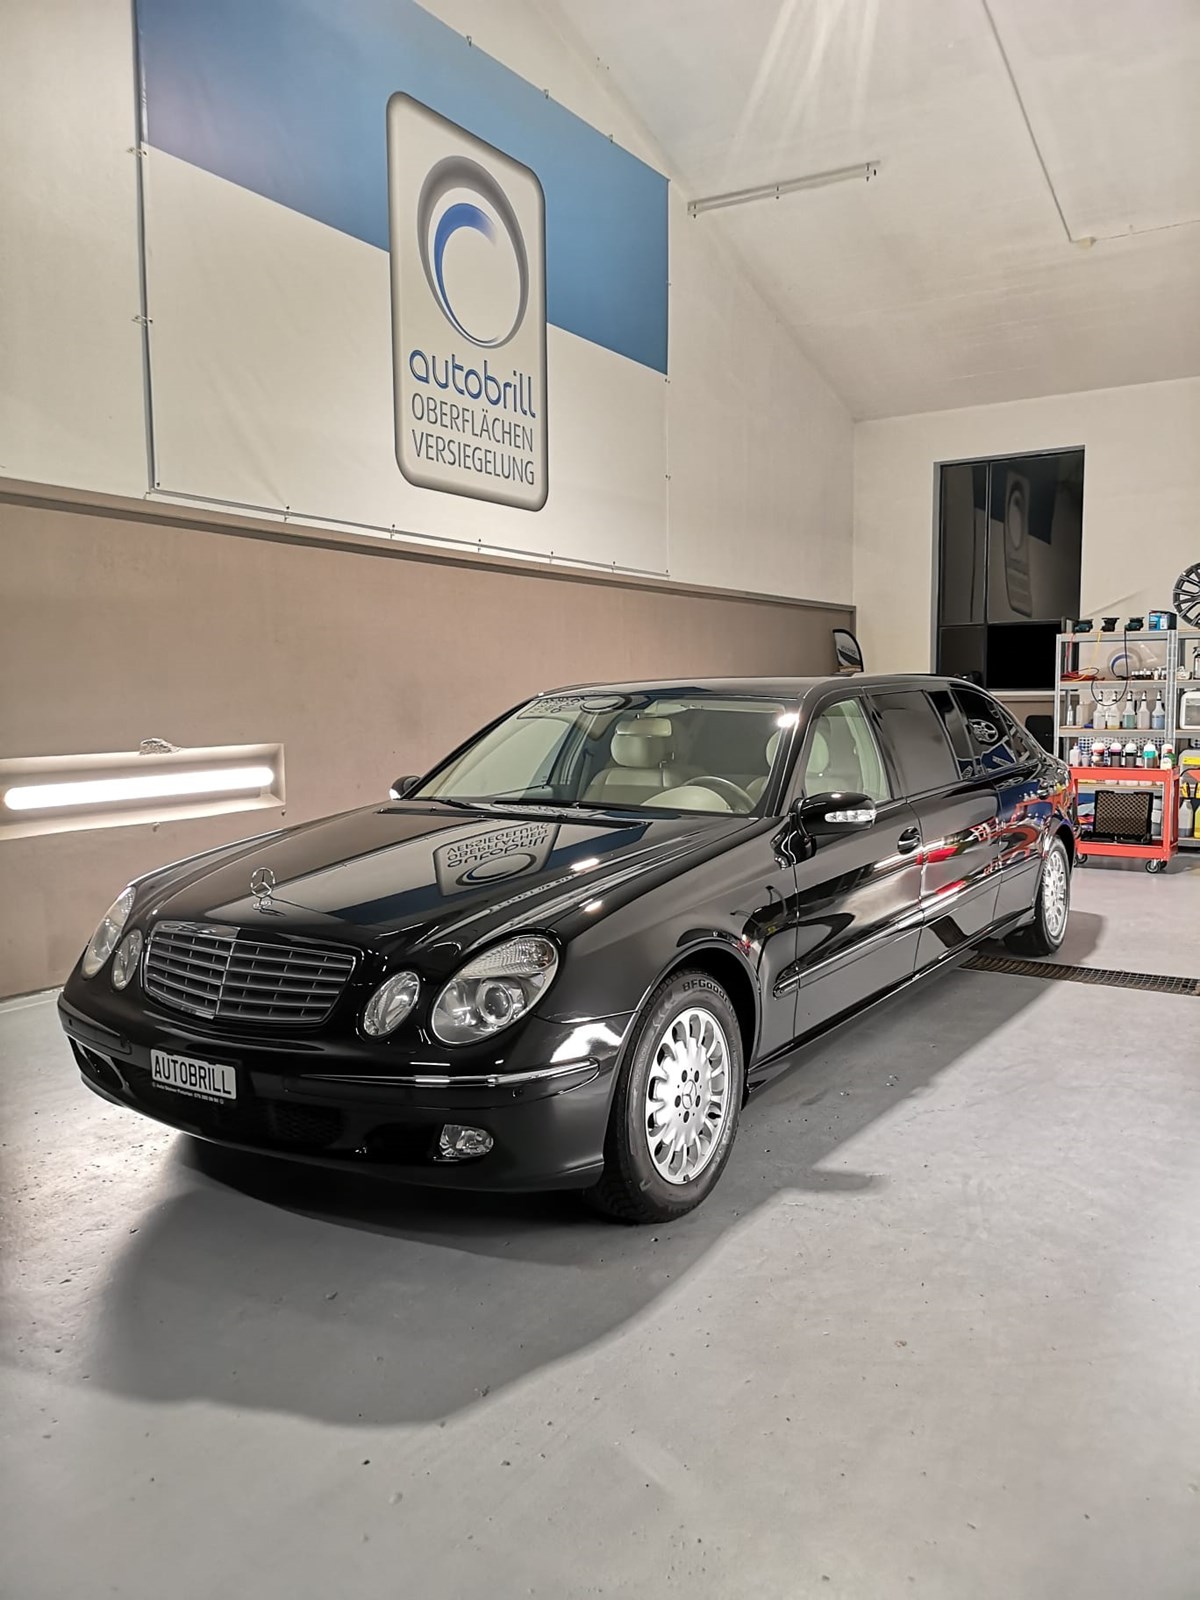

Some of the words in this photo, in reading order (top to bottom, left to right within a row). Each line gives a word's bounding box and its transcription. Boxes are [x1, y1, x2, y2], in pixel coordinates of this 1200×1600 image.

[409, 350, 536, 418] autobrill
[412, 393, 533, 452] OBERFLÄCHEN
[412, 429, 535, 485] VERSIEGELUNG
[155, 1055, 232, 1095] AUTOBRILL
